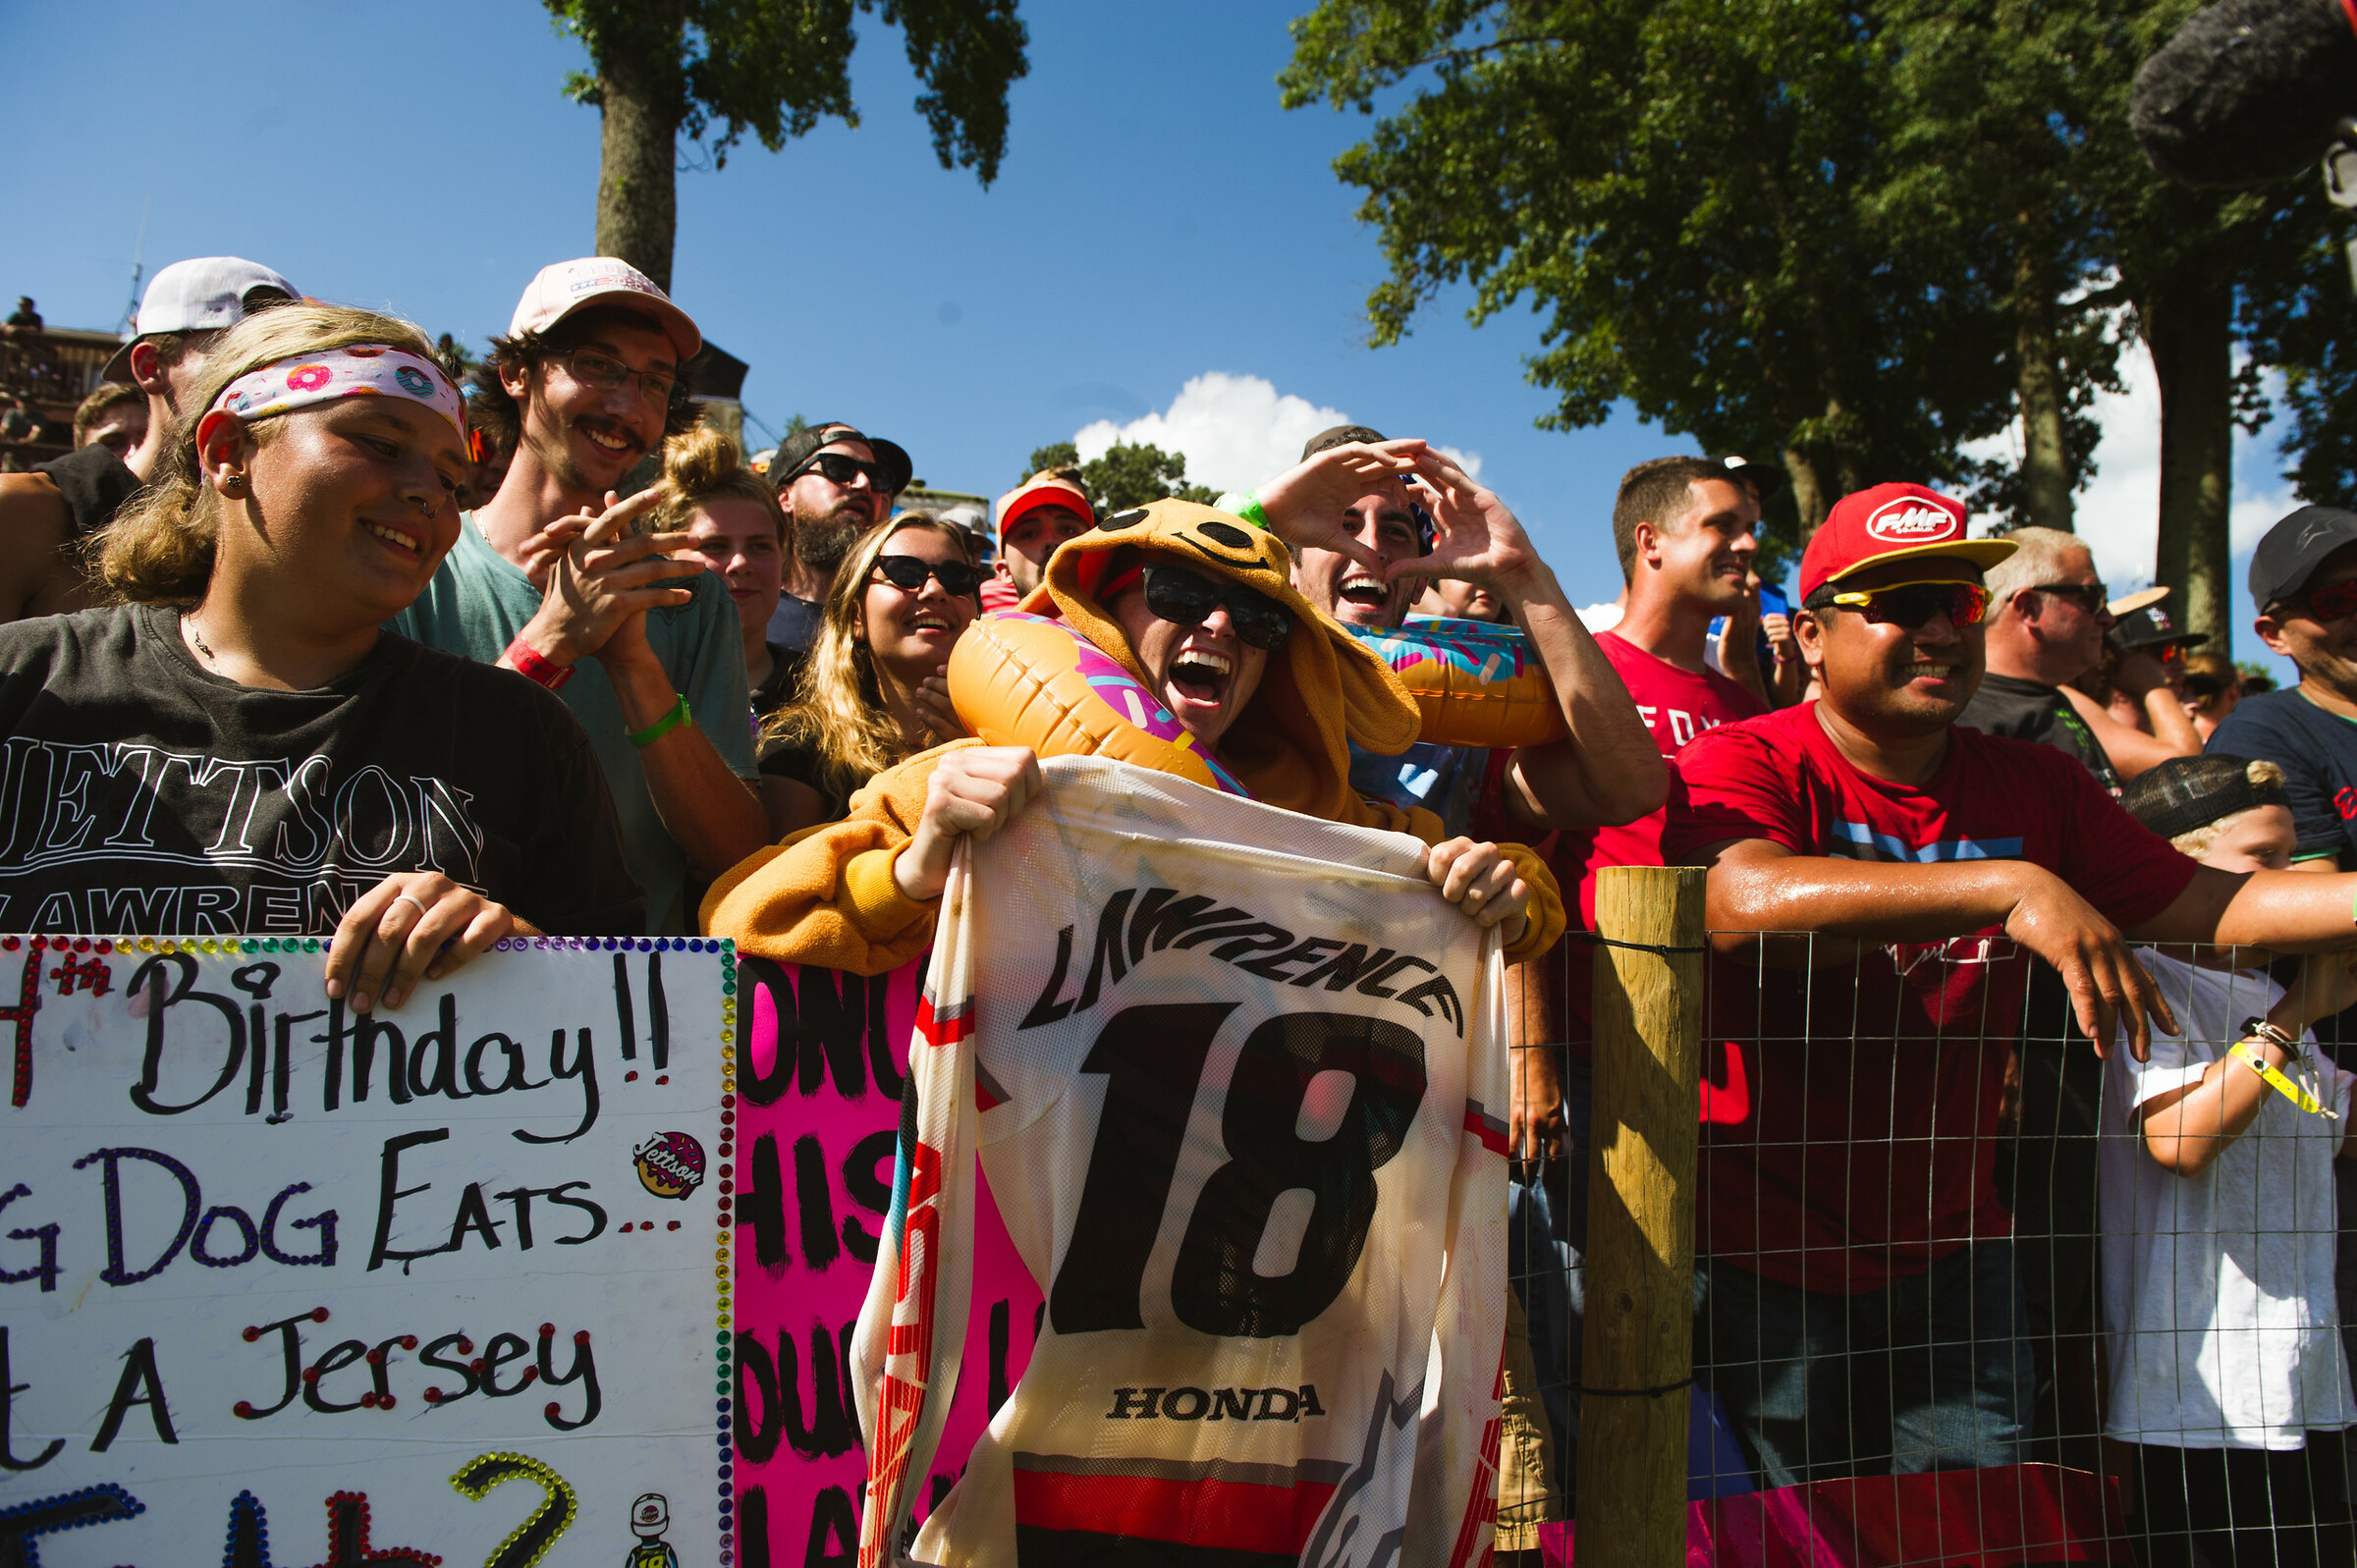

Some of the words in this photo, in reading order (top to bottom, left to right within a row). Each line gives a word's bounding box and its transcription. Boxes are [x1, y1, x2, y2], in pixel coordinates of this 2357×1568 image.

[1875, 507, 1948, 533] FMF
[0, 736, 485, 883] JETTSON
[0, 883, 488, 937] AWREN
[1017, 887, 1464, 1038] LAWRENCE
[633, 1131, 701, 1185] Jettson
[1050, 1001, 1428, 1338] 18
[89, 1336, 180, 1453] A
[234, 1306, 602, 1432] Jersey
[1106, 1383, 1327, 1424] HONDA
